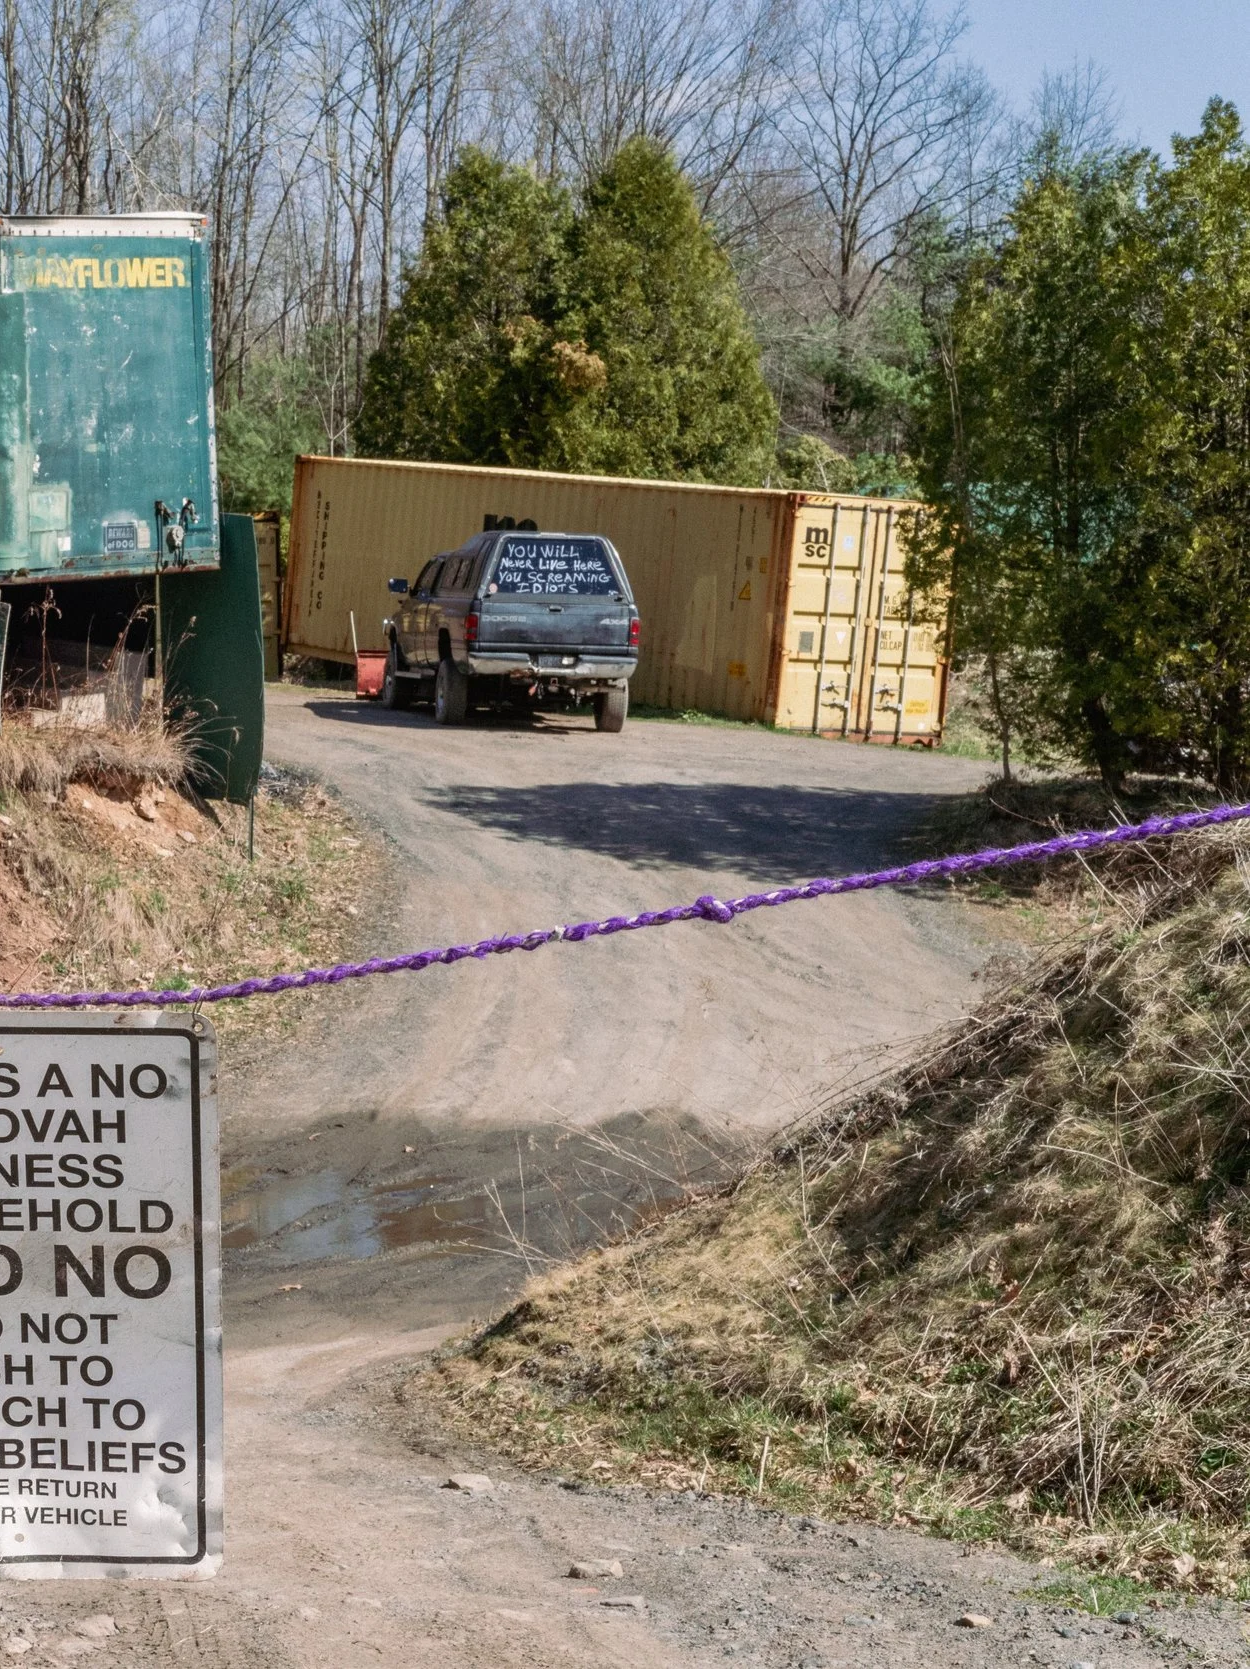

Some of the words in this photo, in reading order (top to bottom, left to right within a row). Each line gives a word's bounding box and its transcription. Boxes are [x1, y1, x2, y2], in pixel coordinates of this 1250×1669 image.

[116, 539, 134, 549] DOG
[319, 502, 330, 580] SHIPPING
[507, 543, 537, 558] YOU
[482, 615, 527, 623] DODGE
[37, 1063, 73, 1098] A
[90, 1063, 168, 1099] NO
[54, 1244, 172, 1299] NO
[20, 1312, 118, 1345] NOT
[49, 1355, 114, 1388] TO
[82, 1398, 147, 1431] TO
[18, 1479, 117, 1499] RETURN
[24, 1507, 128, 1527] VEHICLE
